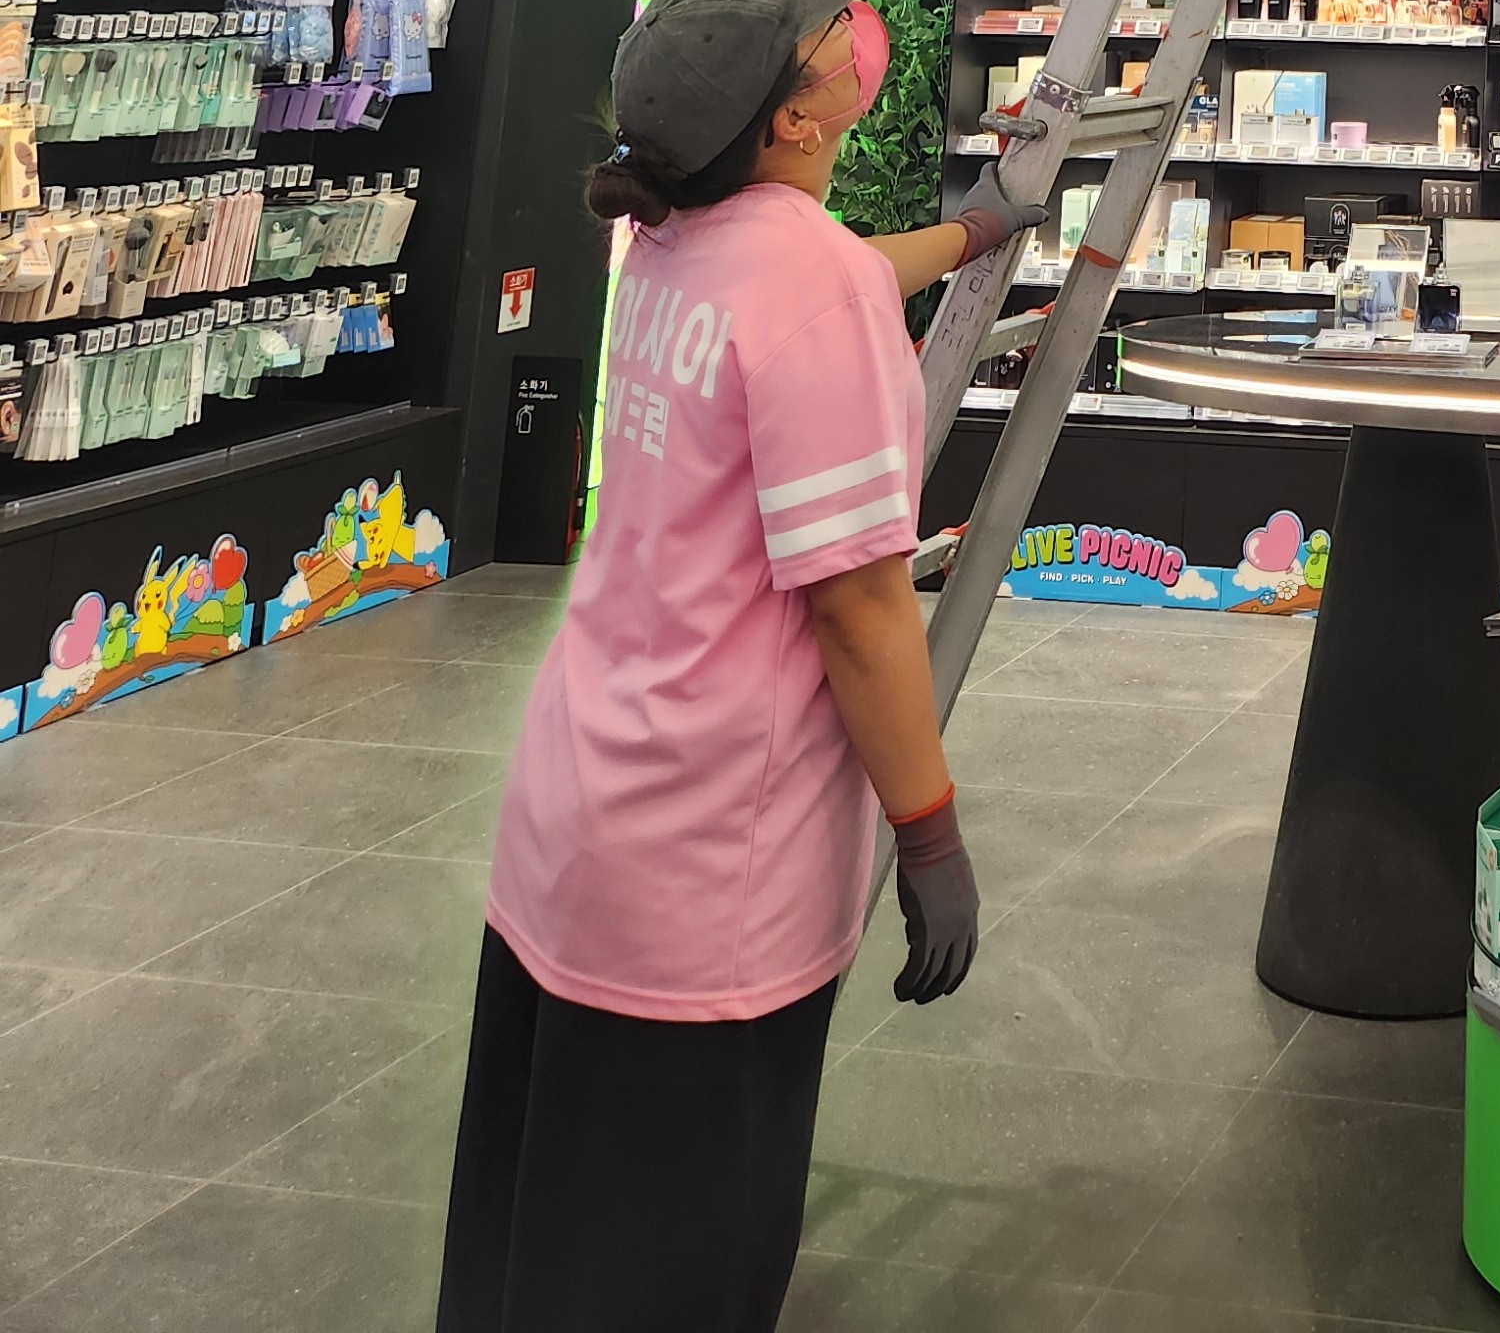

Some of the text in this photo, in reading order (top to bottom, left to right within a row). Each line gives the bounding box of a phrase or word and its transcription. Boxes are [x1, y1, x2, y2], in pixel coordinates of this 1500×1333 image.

[609, 274, 733, 399] 이사이
[519, 379, 548, 391] 소화기
[1005, 528, 1184, 587] LIVE PICNIC
[1040, 572, 1127, 586] FIND PICK PLAY
